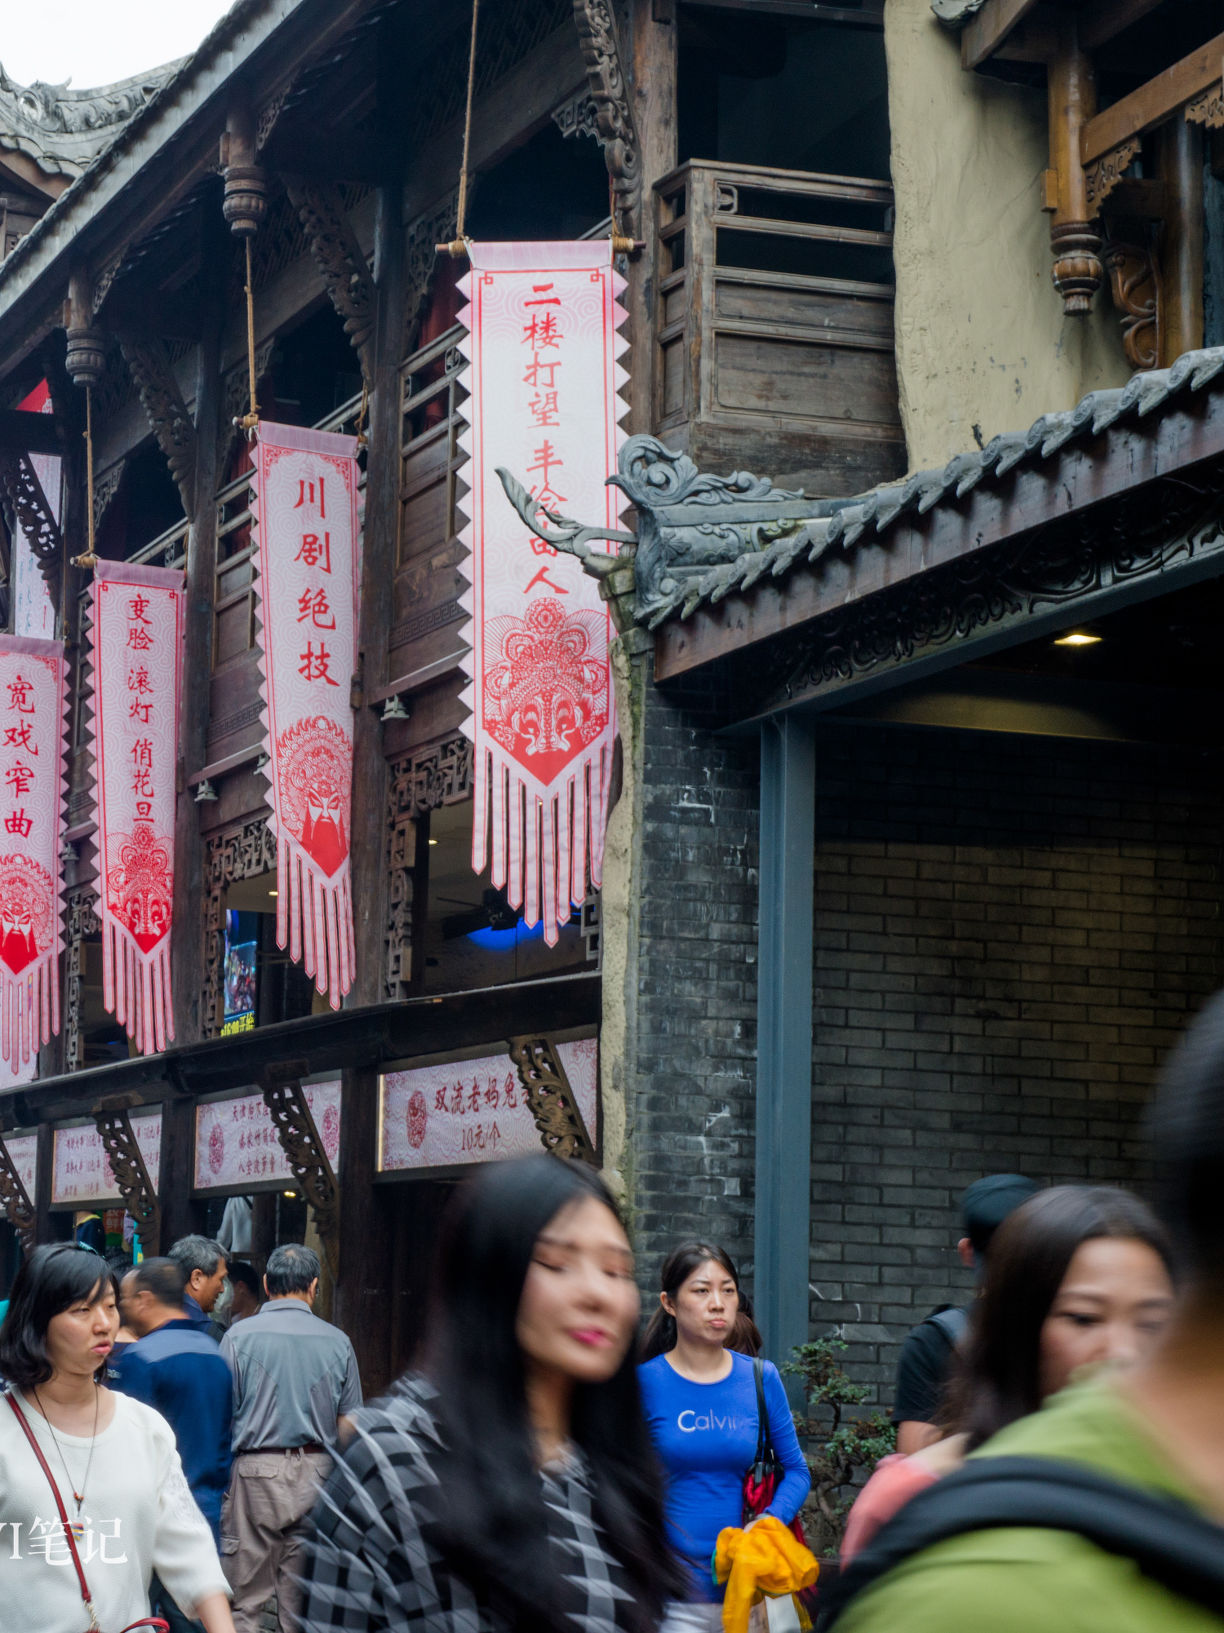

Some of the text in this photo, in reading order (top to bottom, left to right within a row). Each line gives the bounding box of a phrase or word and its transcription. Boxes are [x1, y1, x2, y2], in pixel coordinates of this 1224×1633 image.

[520, 283, 564, 429] 二楼打望
[293, 476, 340, 687] 川剧绝技
[2, 674, 39, 838] 宽戏窄曲
[126, 593, 155, 824] 变脸 滚灯 俏花旦
[434, 1071, 531, 1115] 双流老妈兔
